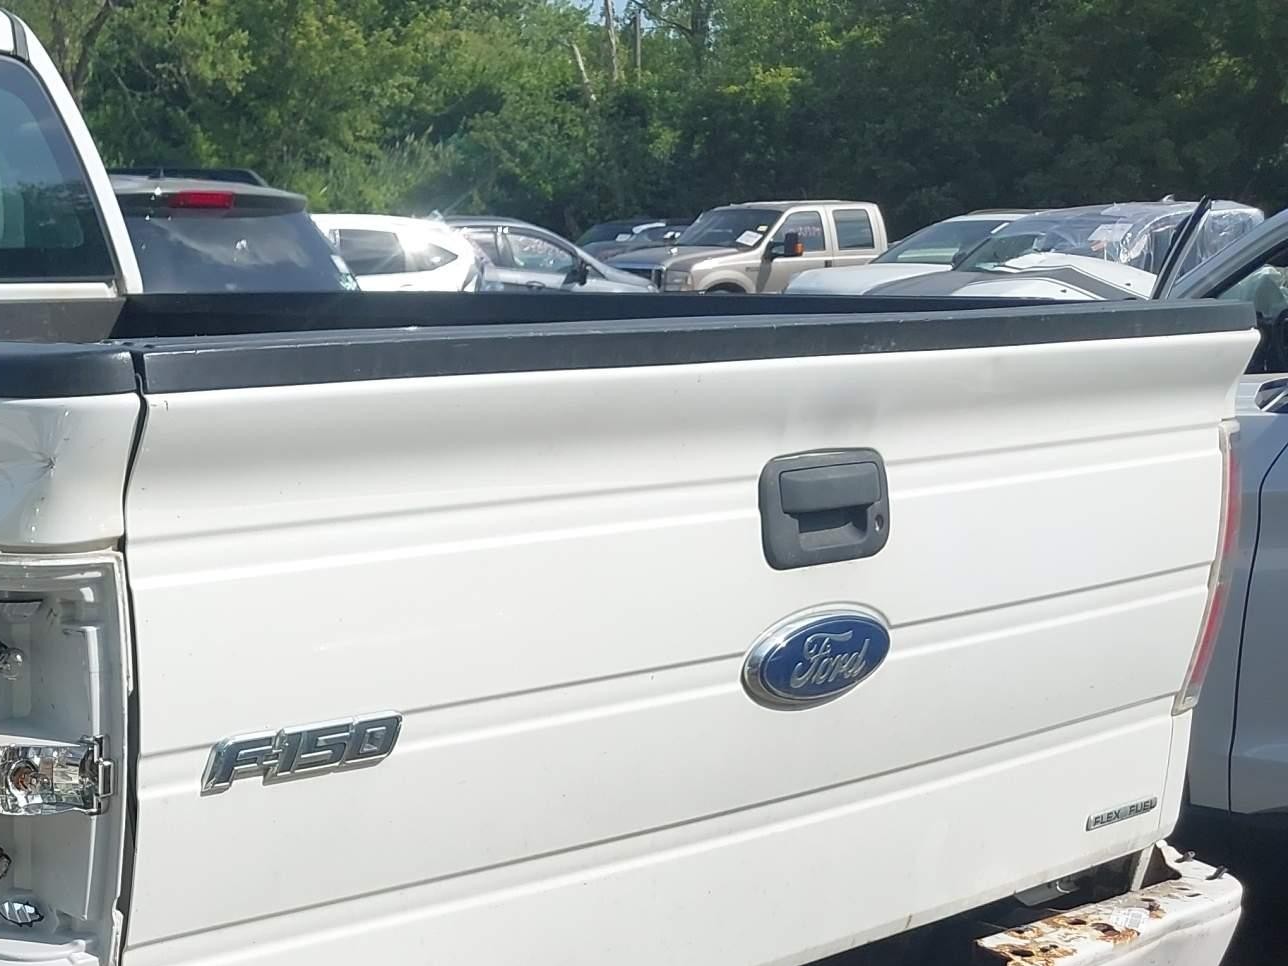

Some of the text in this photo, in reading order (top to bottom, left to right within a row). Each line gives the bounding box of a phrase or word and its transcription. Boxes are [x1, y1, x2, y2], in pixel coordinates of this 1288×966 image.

[789, 630, 871, 689] Ford
[200, 710, 403, 796] F-150
[1093, 798, 1157, 827] FLEX FUEL
